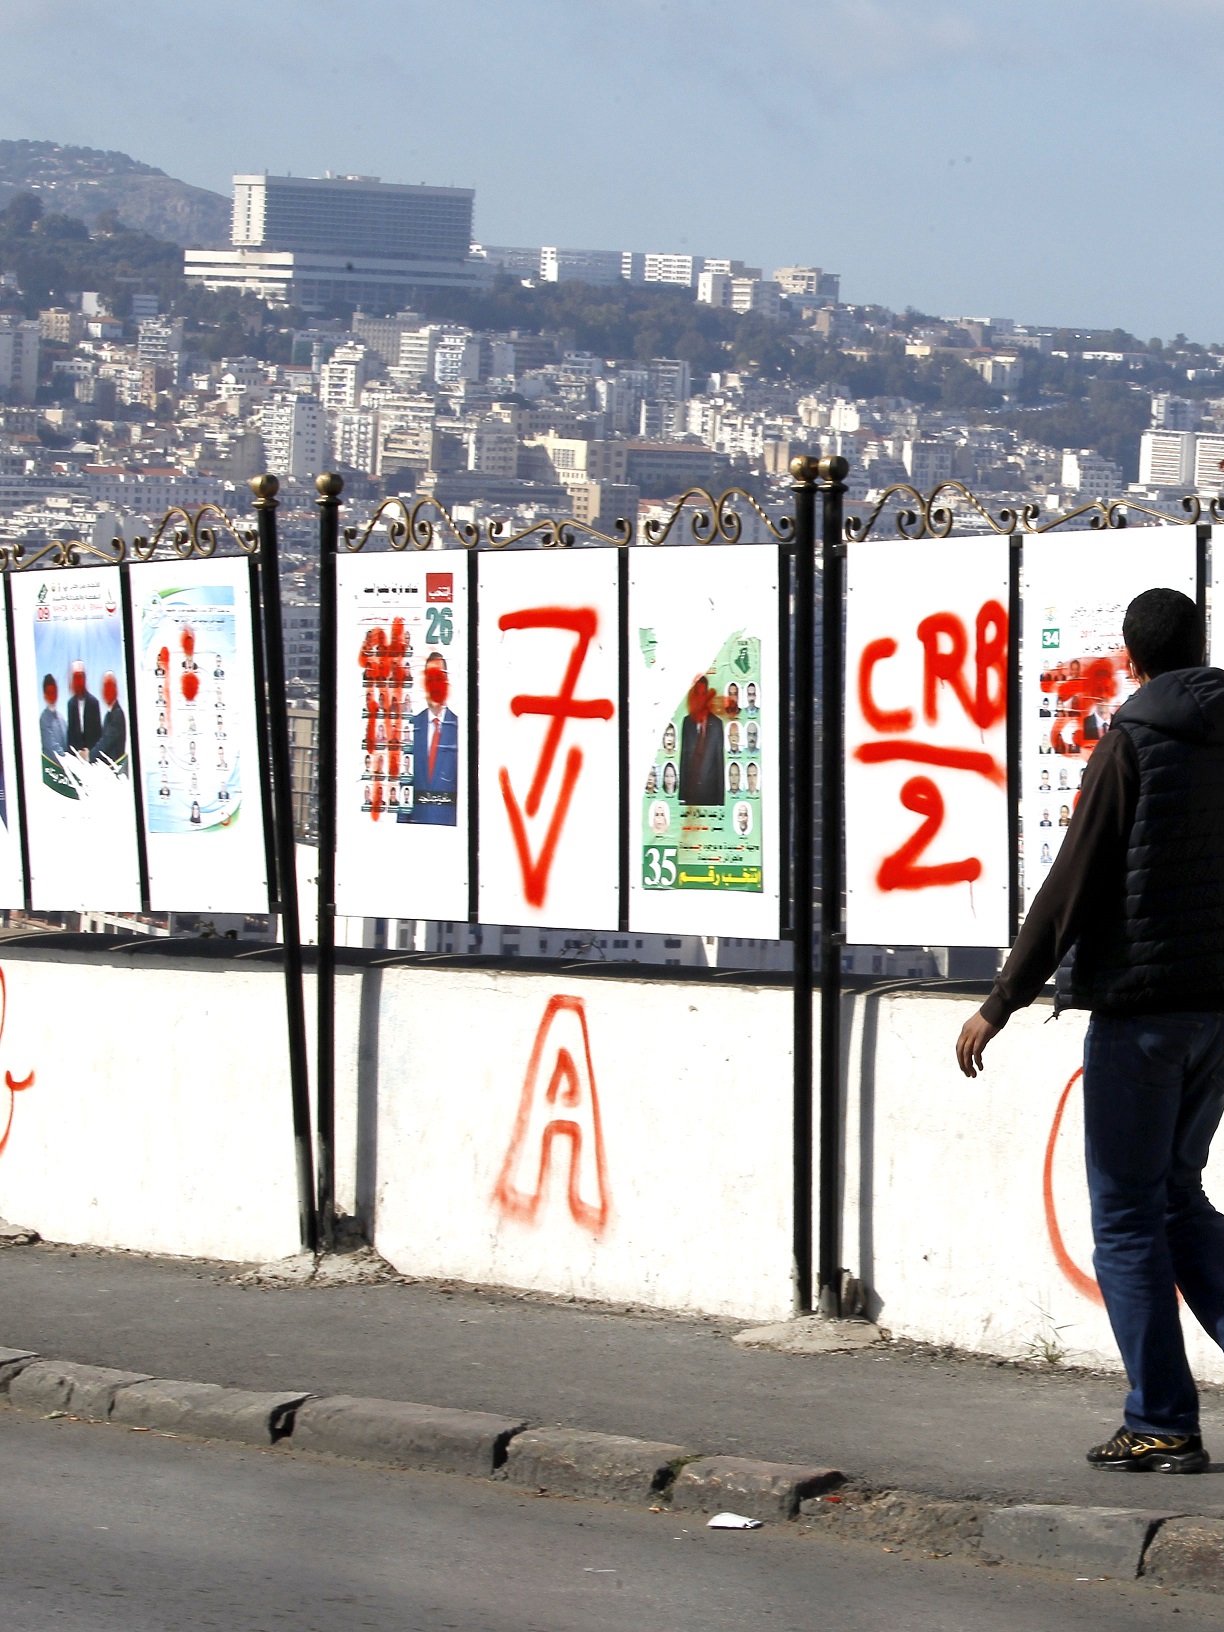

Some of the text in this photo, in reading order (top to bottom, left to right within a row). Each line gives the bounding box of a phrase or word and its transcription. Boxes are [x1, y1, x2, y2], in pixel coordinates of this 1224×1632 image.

[425, 606, 454, 646] 26
[1042, 630, 1060, 647] 34
[858, 600, 1009, 733] CRB
[874, 775, 984, 893] 2
[644, 847, 678, 886] 35
[679, 865, 721, 886] رقم
